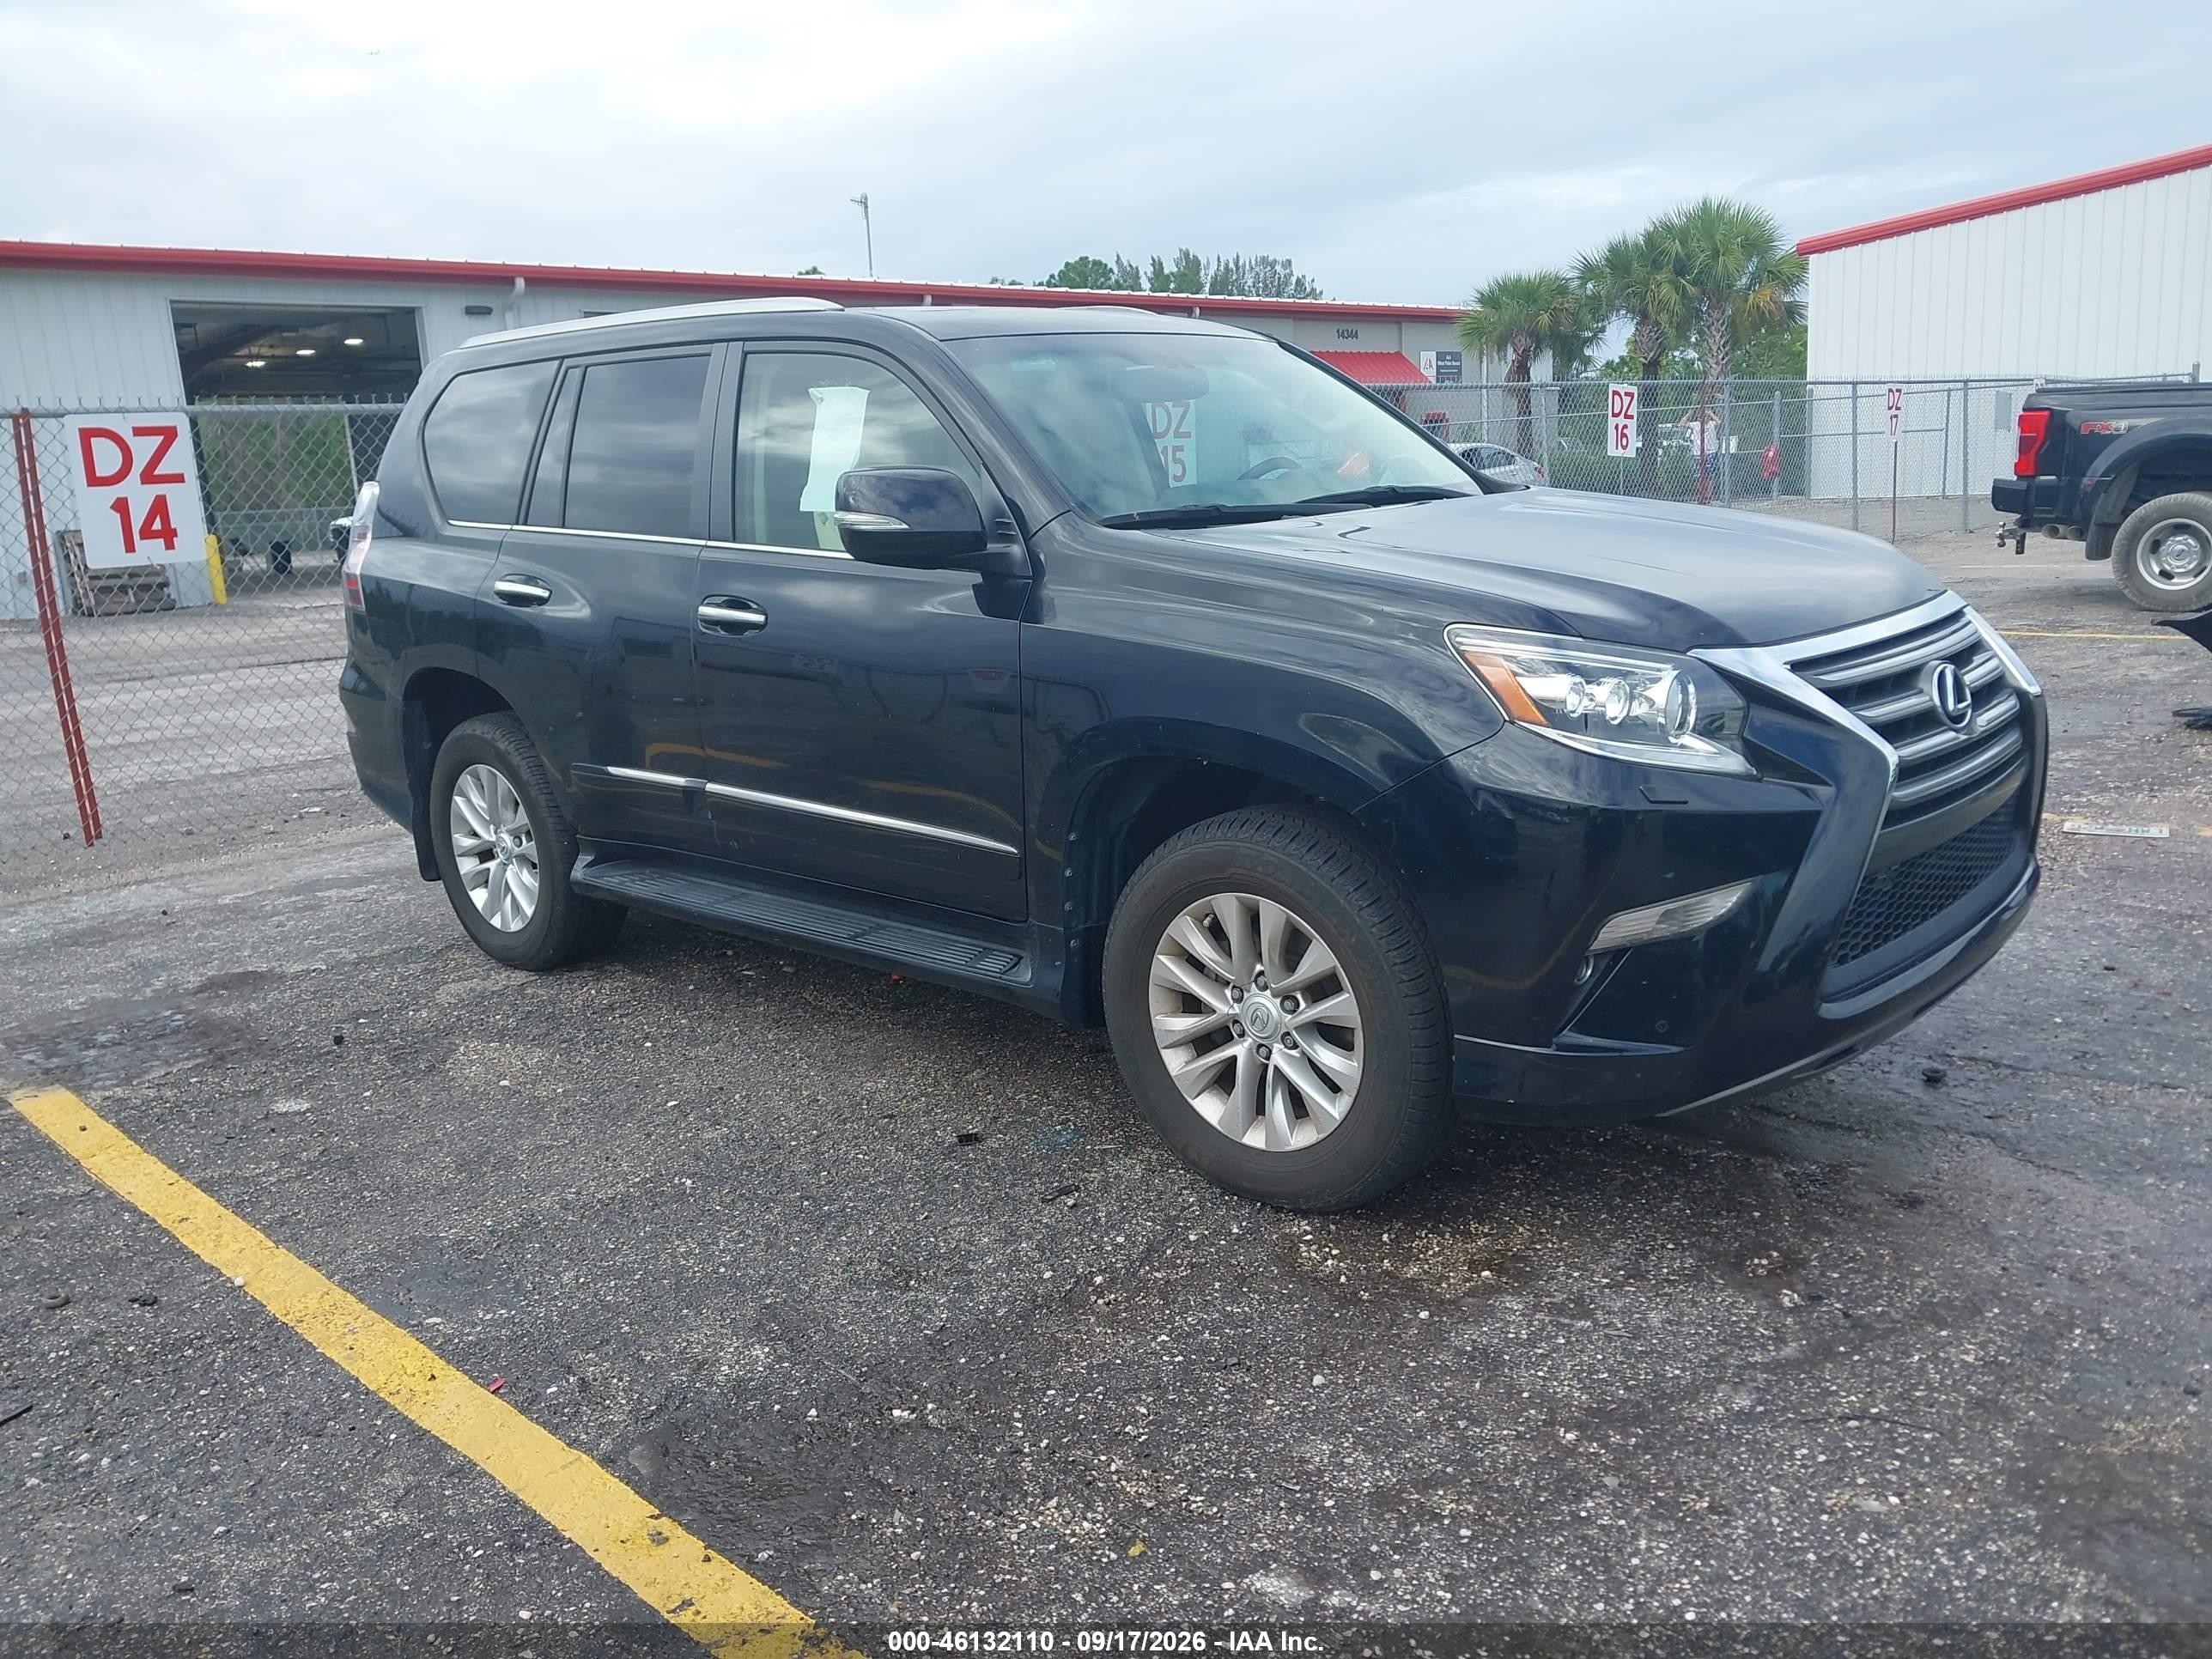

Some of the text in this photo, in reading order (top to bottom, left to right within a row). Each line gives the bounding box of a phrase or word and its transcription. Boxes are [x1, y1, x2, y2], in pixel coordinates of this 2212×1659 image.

[1336, 328, 1358, 340] 14344
[1612, 389, 1635, 420] DZ
[1887, 388, 1902, 410] DZ
[1152, 401, 1191, 439] DZ
[1890, 414, 1899, 436] 17
[1614, 422, 1629, 451] 16
[78, 425, 185, 487] DZ
[110, 494, 178, 553] 14
